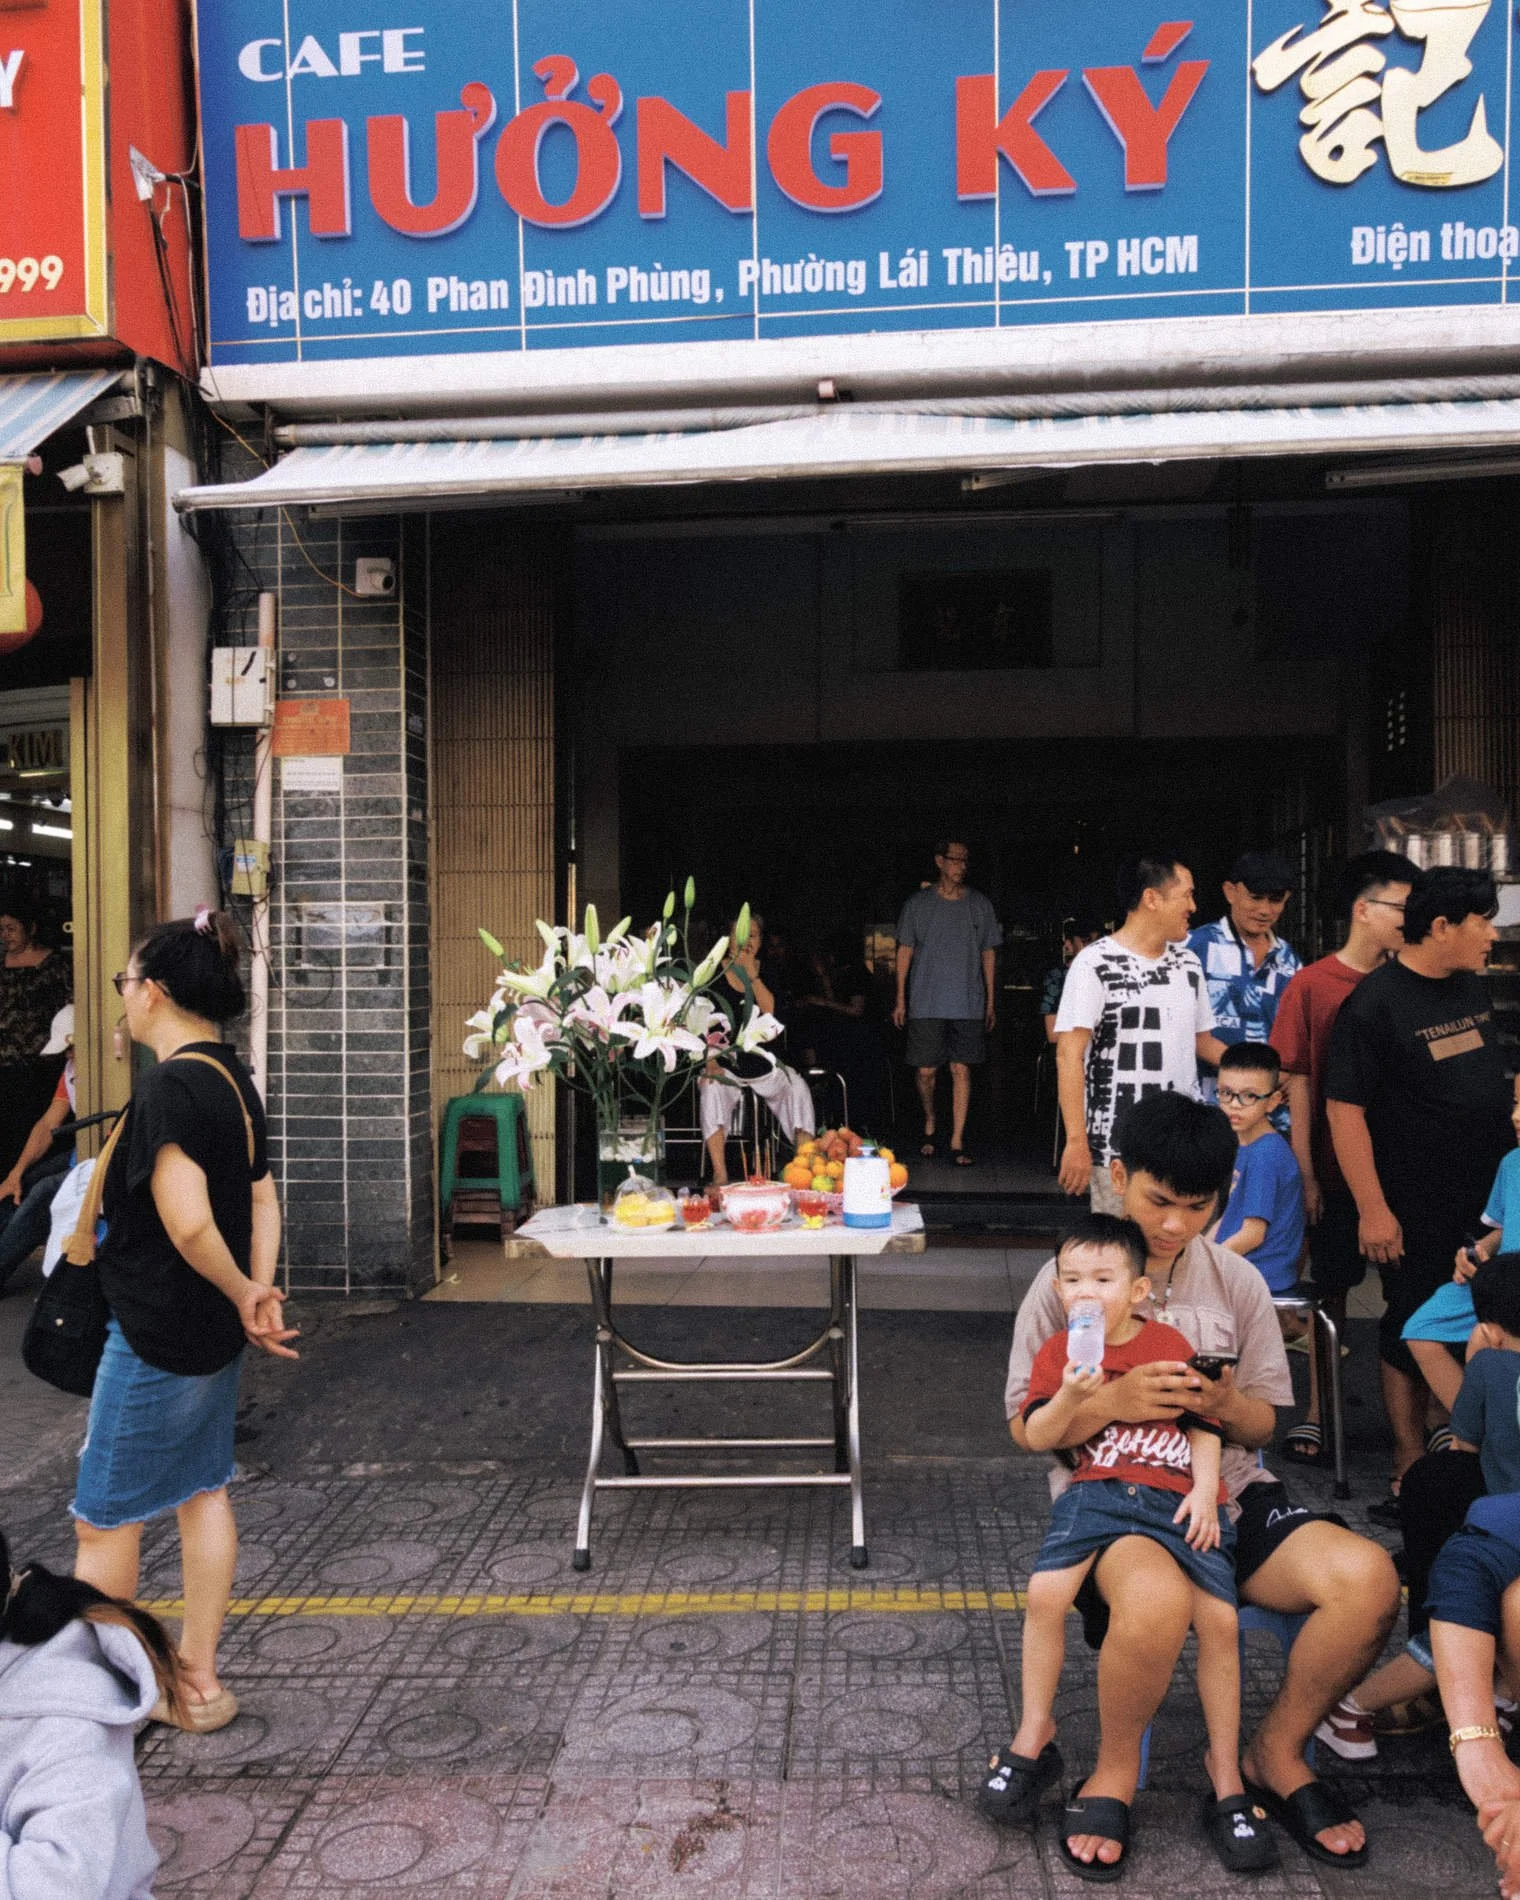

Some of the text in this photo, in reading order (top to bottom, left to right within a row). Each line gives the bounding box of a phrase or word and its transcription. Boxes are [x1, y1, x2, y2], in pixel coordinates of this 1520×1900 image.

[238, 27, 425, 82] CAFE
[234, 21, 1210, 241] HƯỞNG KÝ
[246, 285, 297, 327] Địa
[303, 277, 363, 320] chỉ:
[370, 278, 412, 315] 40
[427, 276, 509, 313] Phan
[523, 268, 597, 308] Đình
[738, 253, 867, 297] Phường
[879, 247, 928, 289] Lái
[943, 243, 1052, 286] Thiêu,
[1064, 240, 1109, 279] TP
[1117, 235, 1199, 277] HCM
[1351, 222, 1431, 271] Điện
